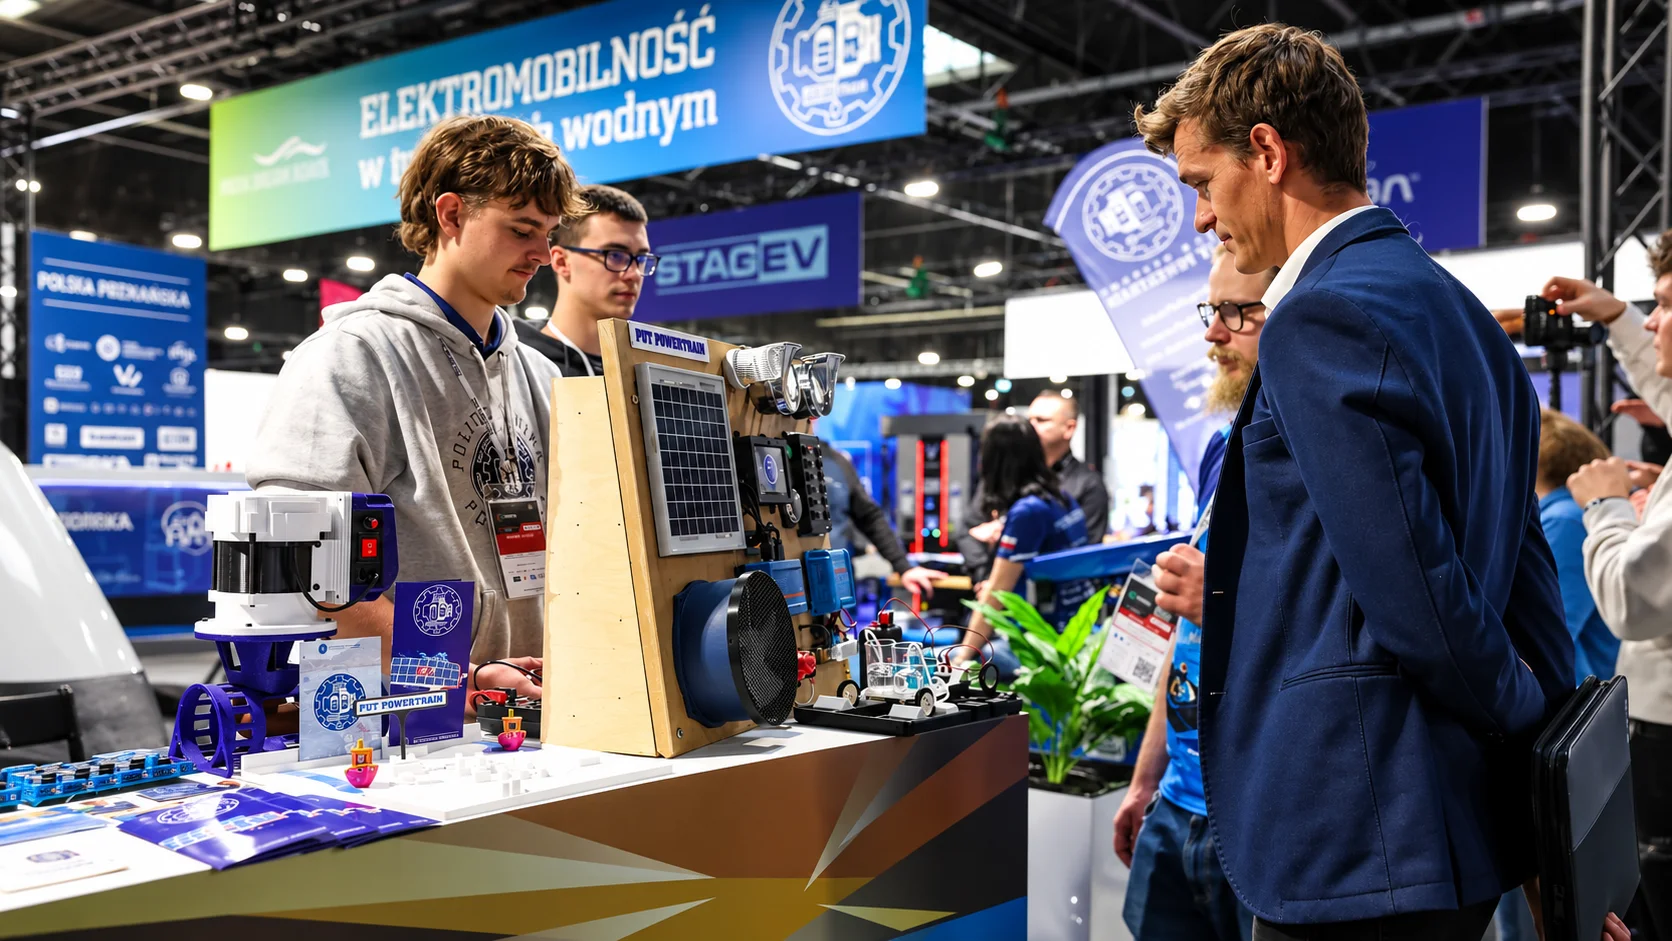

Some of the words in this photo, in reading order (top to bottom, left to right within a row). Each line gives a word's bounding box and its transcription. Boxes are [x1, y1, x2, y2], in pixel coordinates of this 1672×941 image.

[359, 3, 717, 140] ELEKTROMOBILNOŚĆ
[358, 155, 385, 189] w
[560, 88, 719, 152] wodnym
[635, 327, 653, 345] PUT
[654, 332, 706, 356] POWERTRAIN
[359, 702, 380, 713] PUT
[381, 694, 444, 710] POWERTRAIN
